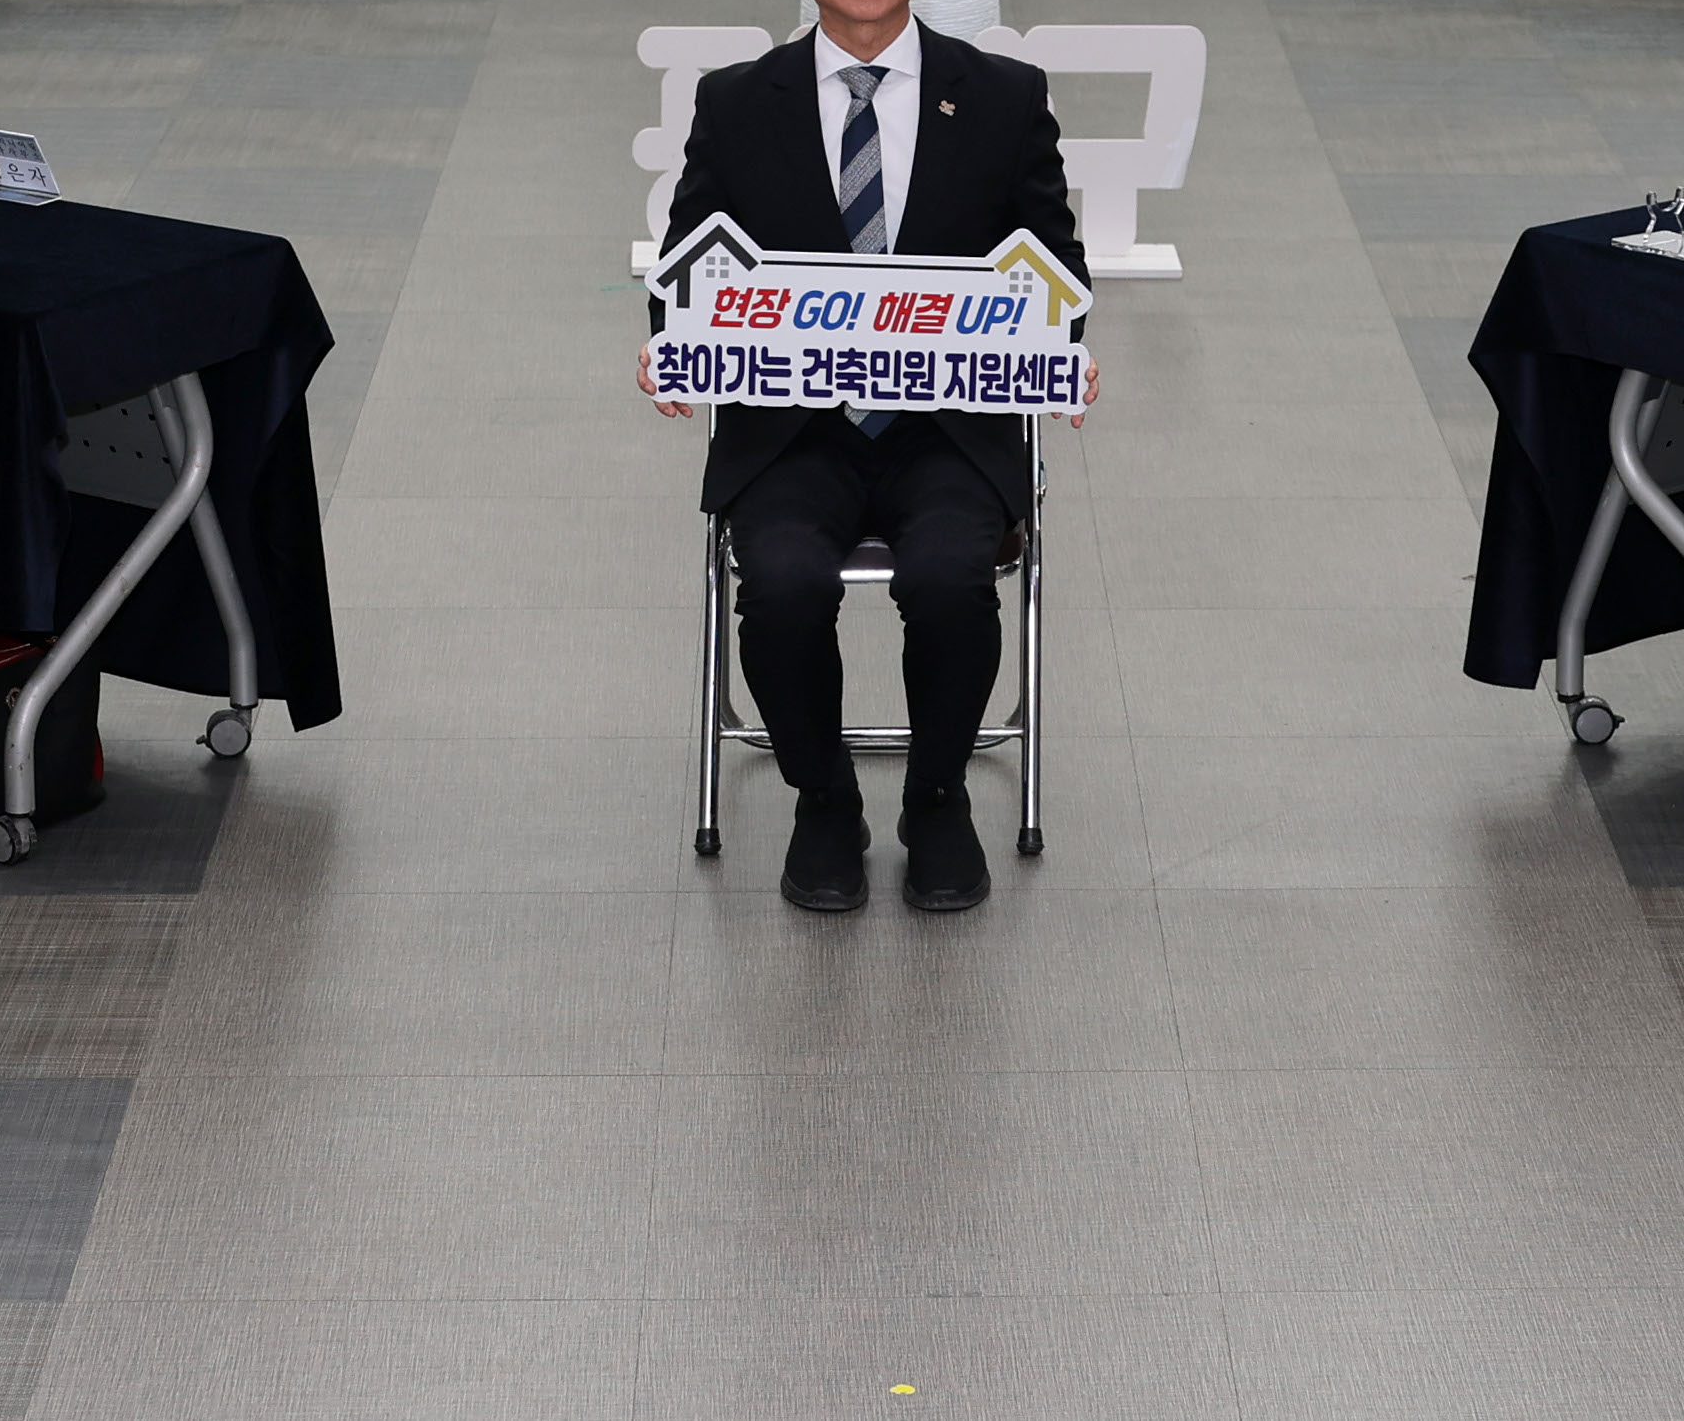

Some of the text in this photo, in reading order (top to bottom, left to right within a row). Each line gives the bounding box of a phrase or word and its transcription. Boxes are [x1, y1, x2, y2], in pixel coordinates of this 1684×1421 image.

[710, 286, 1028, 335] 현장 GO! 해결 UP!
[657, 342, 1080, 406] 찾아가는 건축민원 지원센터
